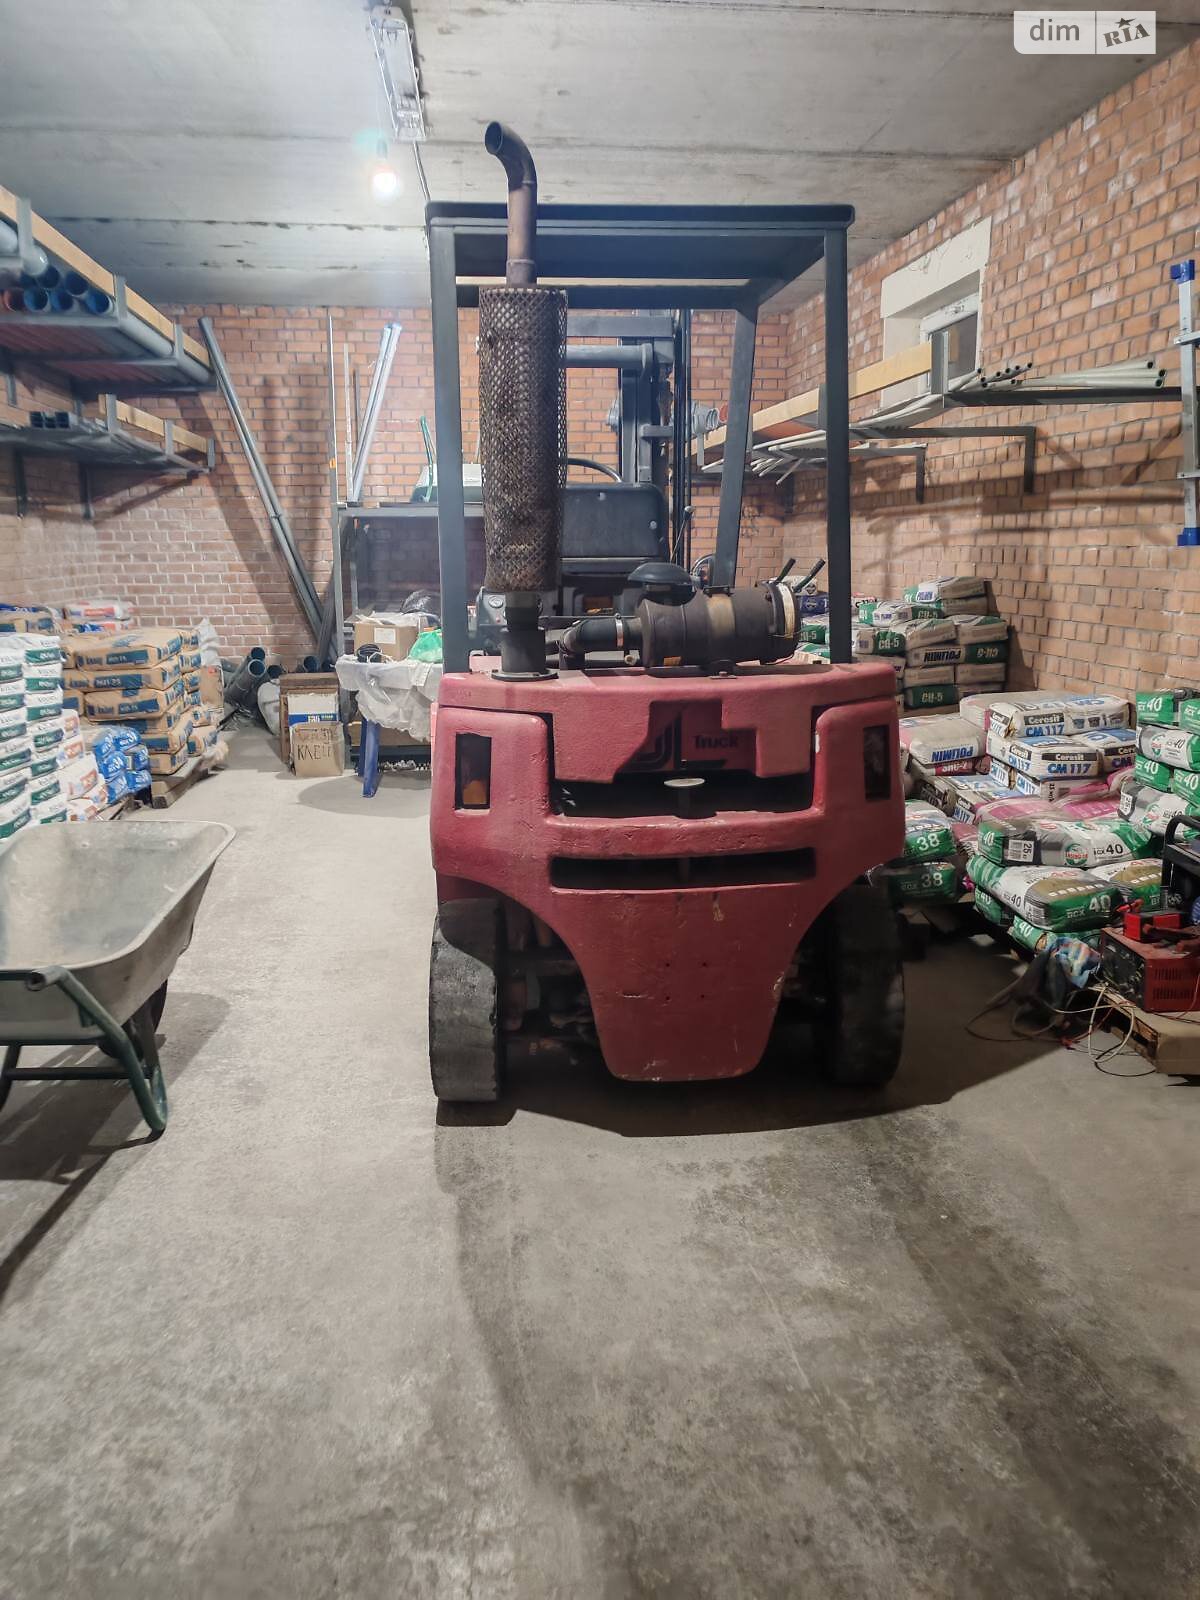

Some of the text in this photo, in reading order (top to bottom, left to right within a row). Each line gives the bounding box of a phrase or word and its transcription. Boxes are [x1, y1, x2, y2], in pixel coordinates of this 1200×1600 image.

[1146, 696, 1163, 711] 40
[1028, 715, 1061, 724] Ceresit
[1026, 724, 1065, 736] CM 117
[1055, 753, 1085, 761] Ceresit
[1047, 763, 1092, 774] CM 117
[1144, 760, 1159, 775] 40
[1184, 773, 1199, 791] 40
[916, 832, 940, 851] 38
[1106, 843, 1124, 855] 40
[921, 872, 943, 888] 38
[1010, 893, 1022, 908] 40
[1089, 894, 1112, 913] 40
[1019, 921, 1034, 938] 40
